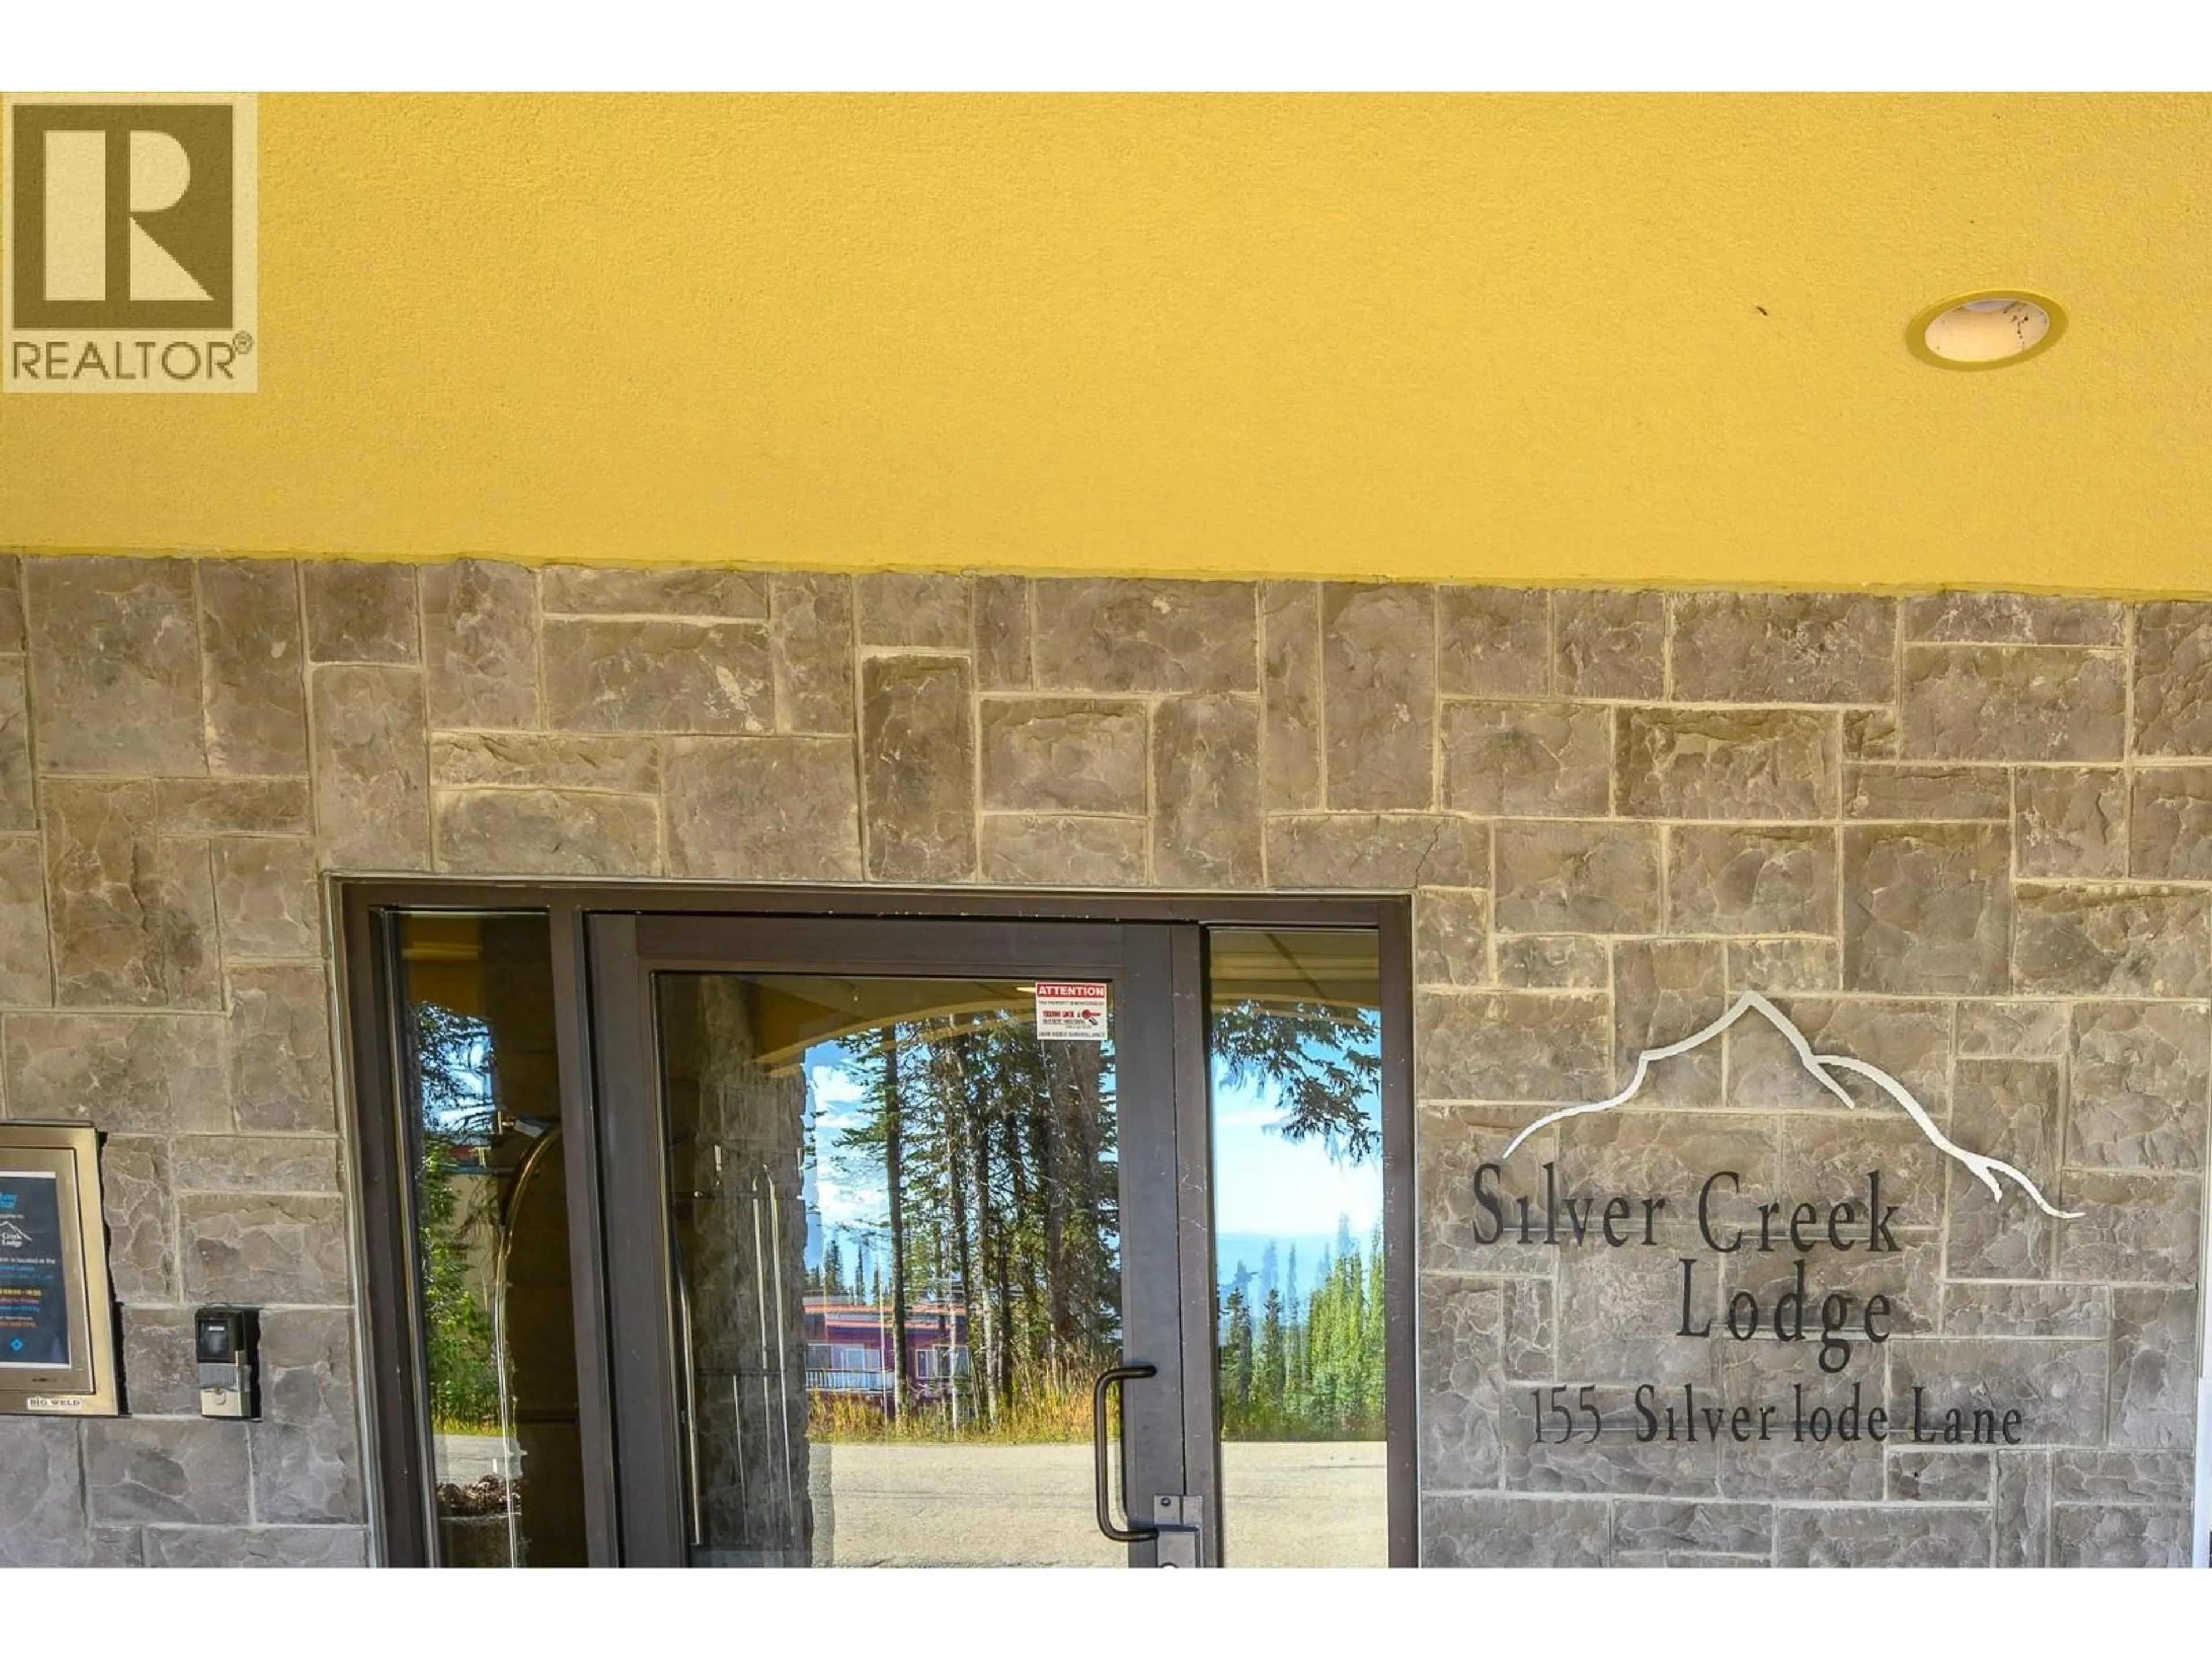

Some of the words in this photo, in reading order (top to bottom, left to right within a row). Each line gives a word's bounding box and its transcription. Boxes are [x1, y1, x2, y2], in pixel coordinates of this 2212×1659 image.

[1039, 986, 1104, 996] ATTENTION
[1472, 1161, 1666, 1247] Silver
[1698, 1169, 1902, 1253] Creek
[1676, 1258, 1891, 1373] Lodge
[1531, 1384, 1602, 1444] 155
[1911, 1385, 2022, 1445] Lane
